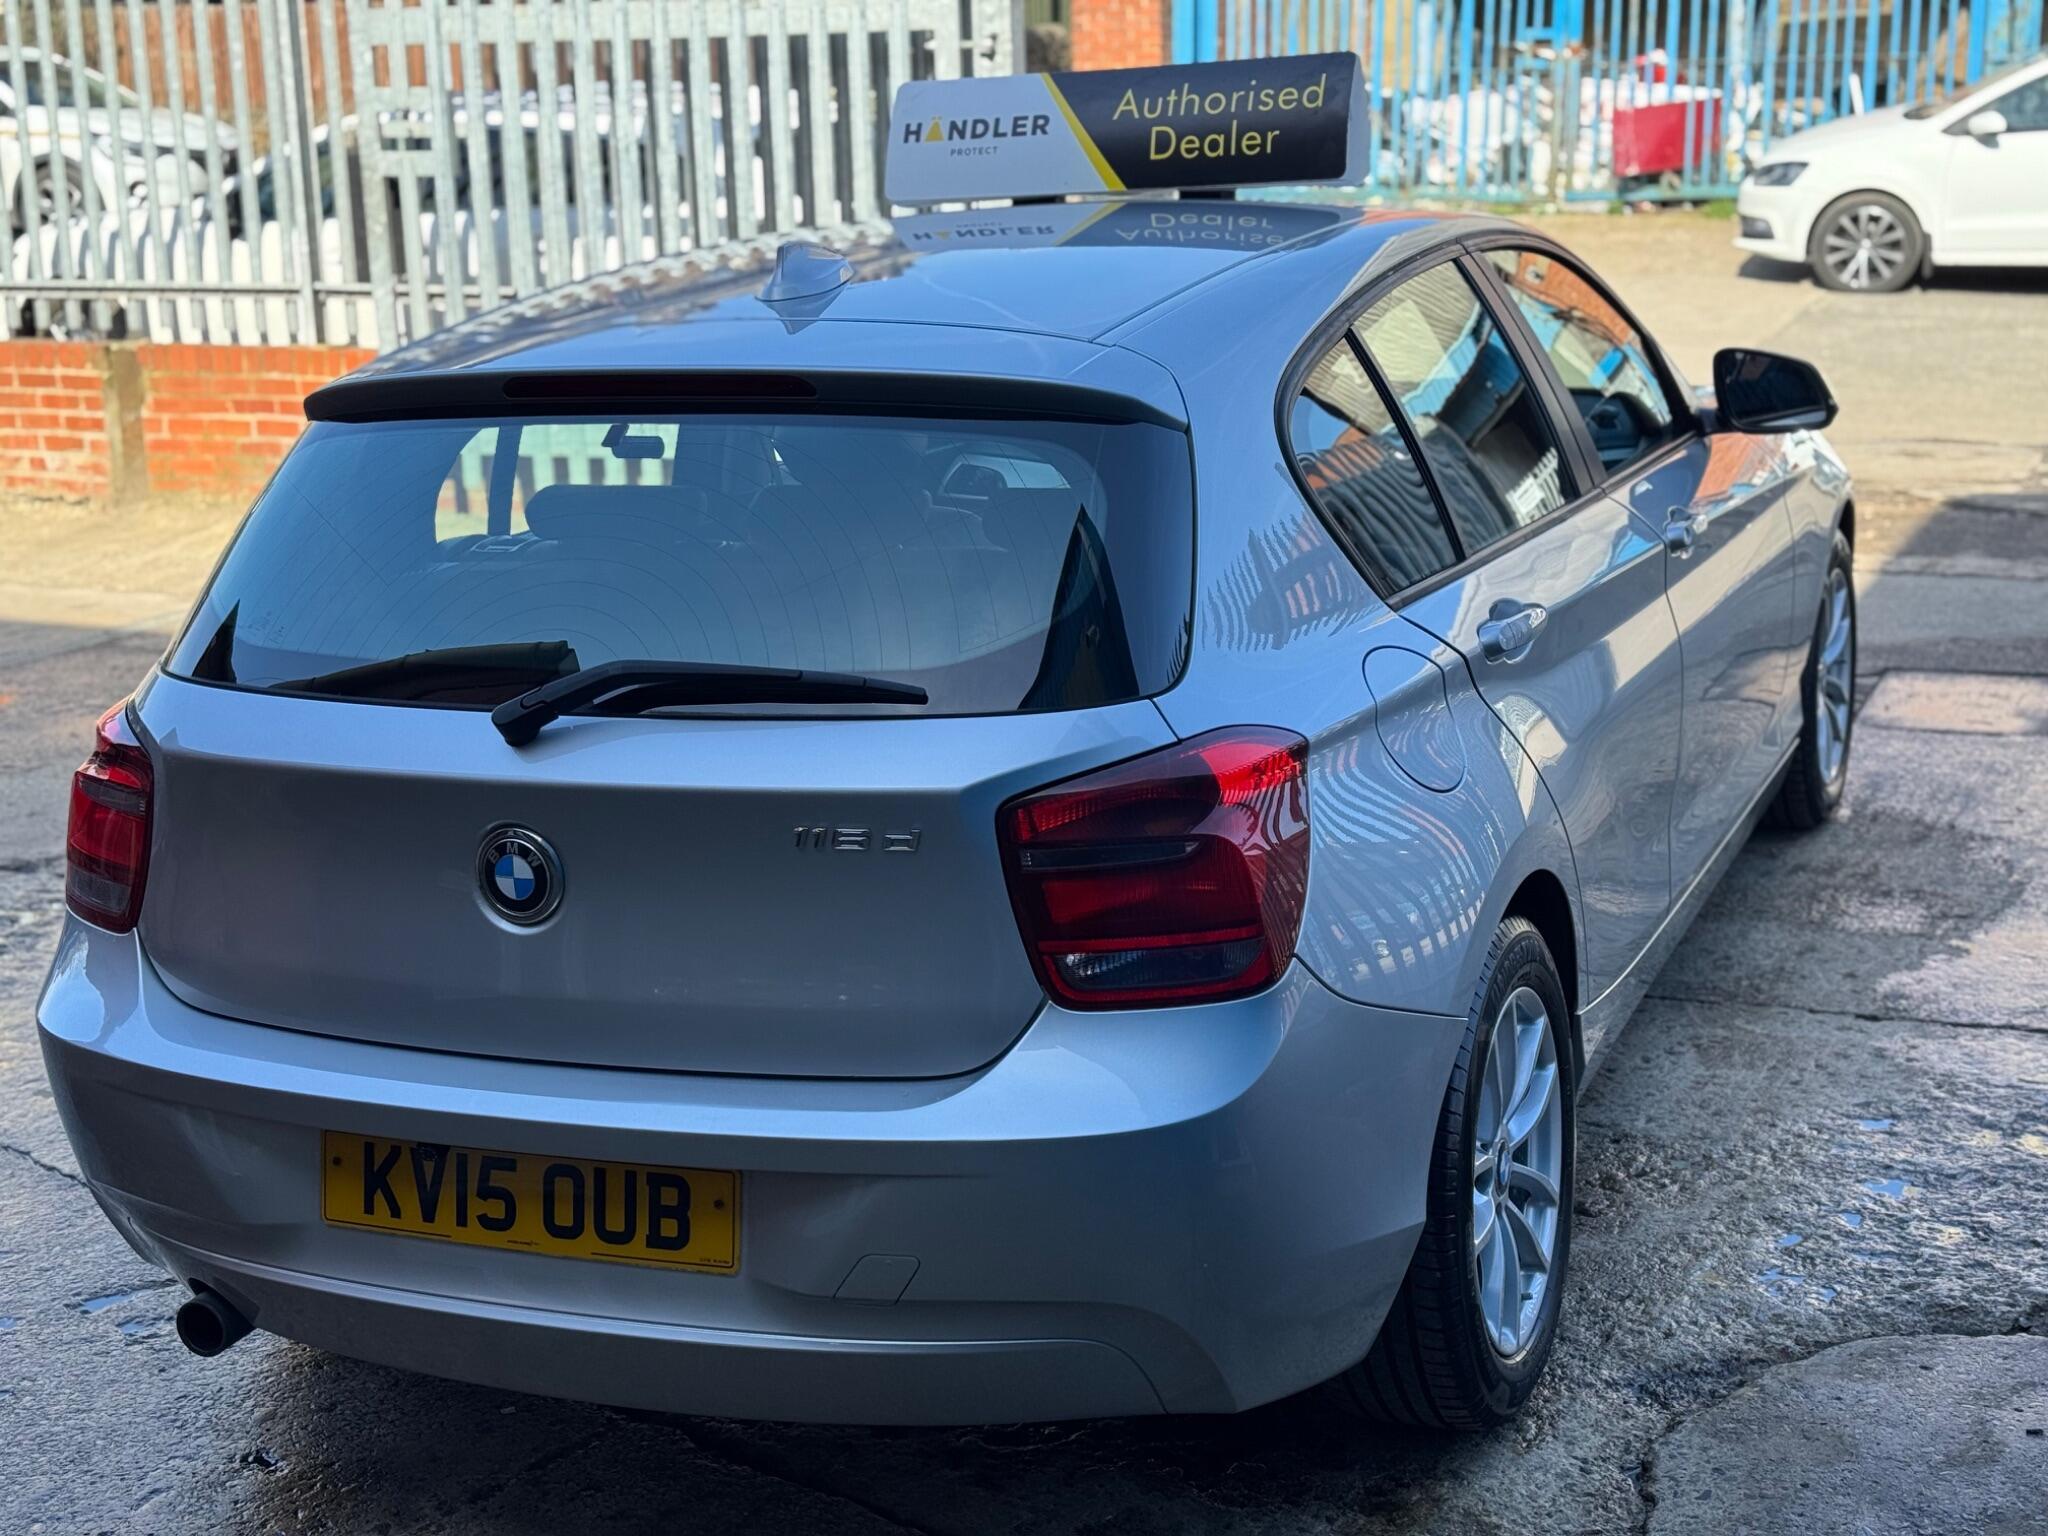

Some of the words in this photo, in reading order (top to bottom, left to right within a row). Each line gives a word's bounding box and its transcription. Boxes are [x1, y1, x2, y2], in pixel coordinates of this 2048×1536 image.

[1112, 73, 1327, 121] Authorised
[950, 146, 999, 157] PROTECT
[1150, 119, 1281, 161] Dealer
[487, 841, 541, 868] BMW
[883, 828, 921, 851] d
[362, 1140, 518, 1233] KV15
[541, 1162, 693, 1253] OUB
